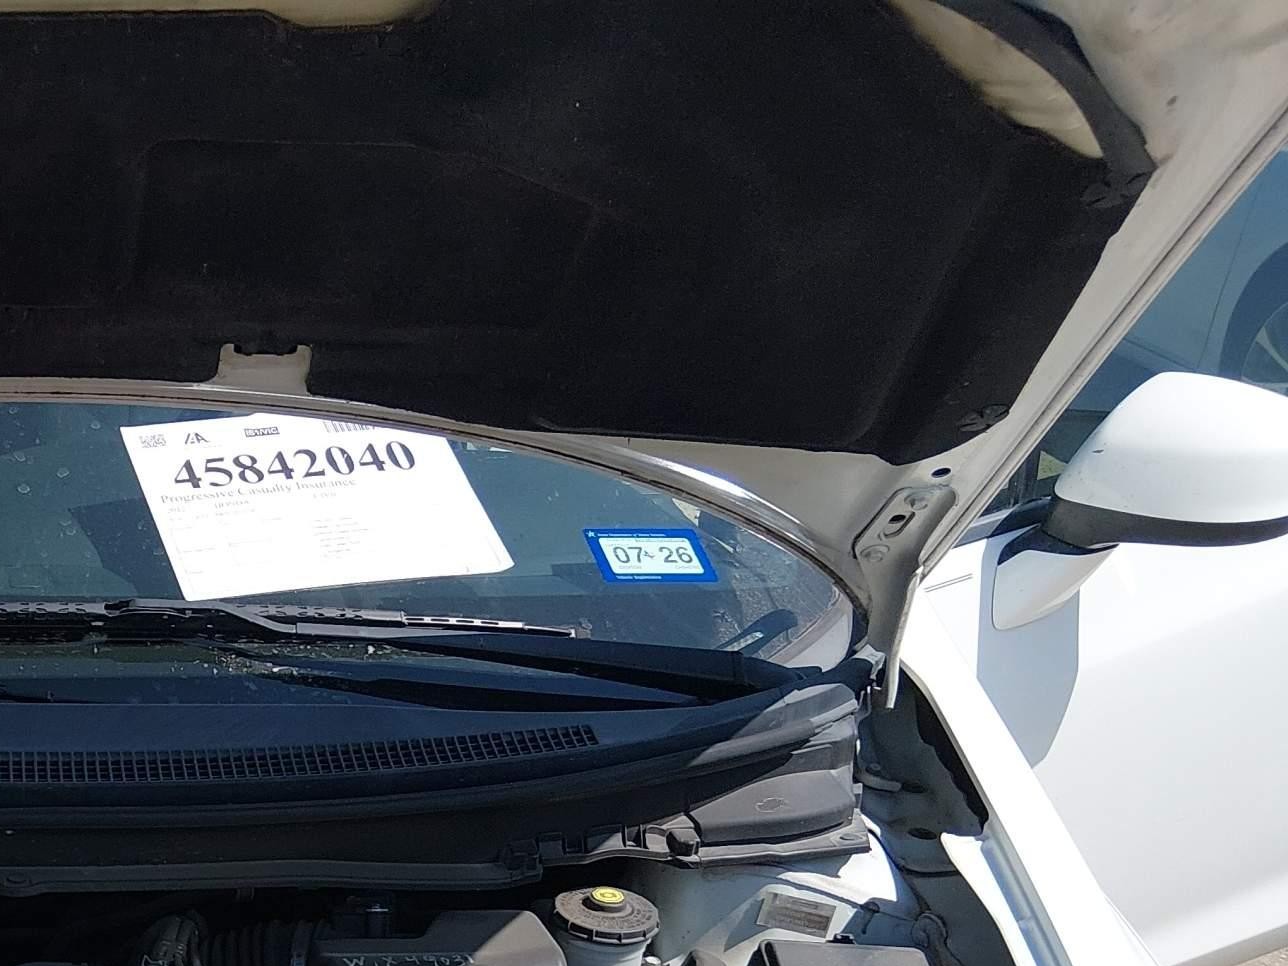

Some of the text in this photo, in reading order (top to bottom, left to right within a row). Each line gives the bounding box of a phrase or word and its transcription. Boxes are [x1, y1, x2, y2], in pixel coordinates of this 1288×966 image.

[174, 440, 415, 488] 45842040
[161, 479, 356, 504] Progressive Casualty Insurance
[612, 546, 694, 564] 07 26
